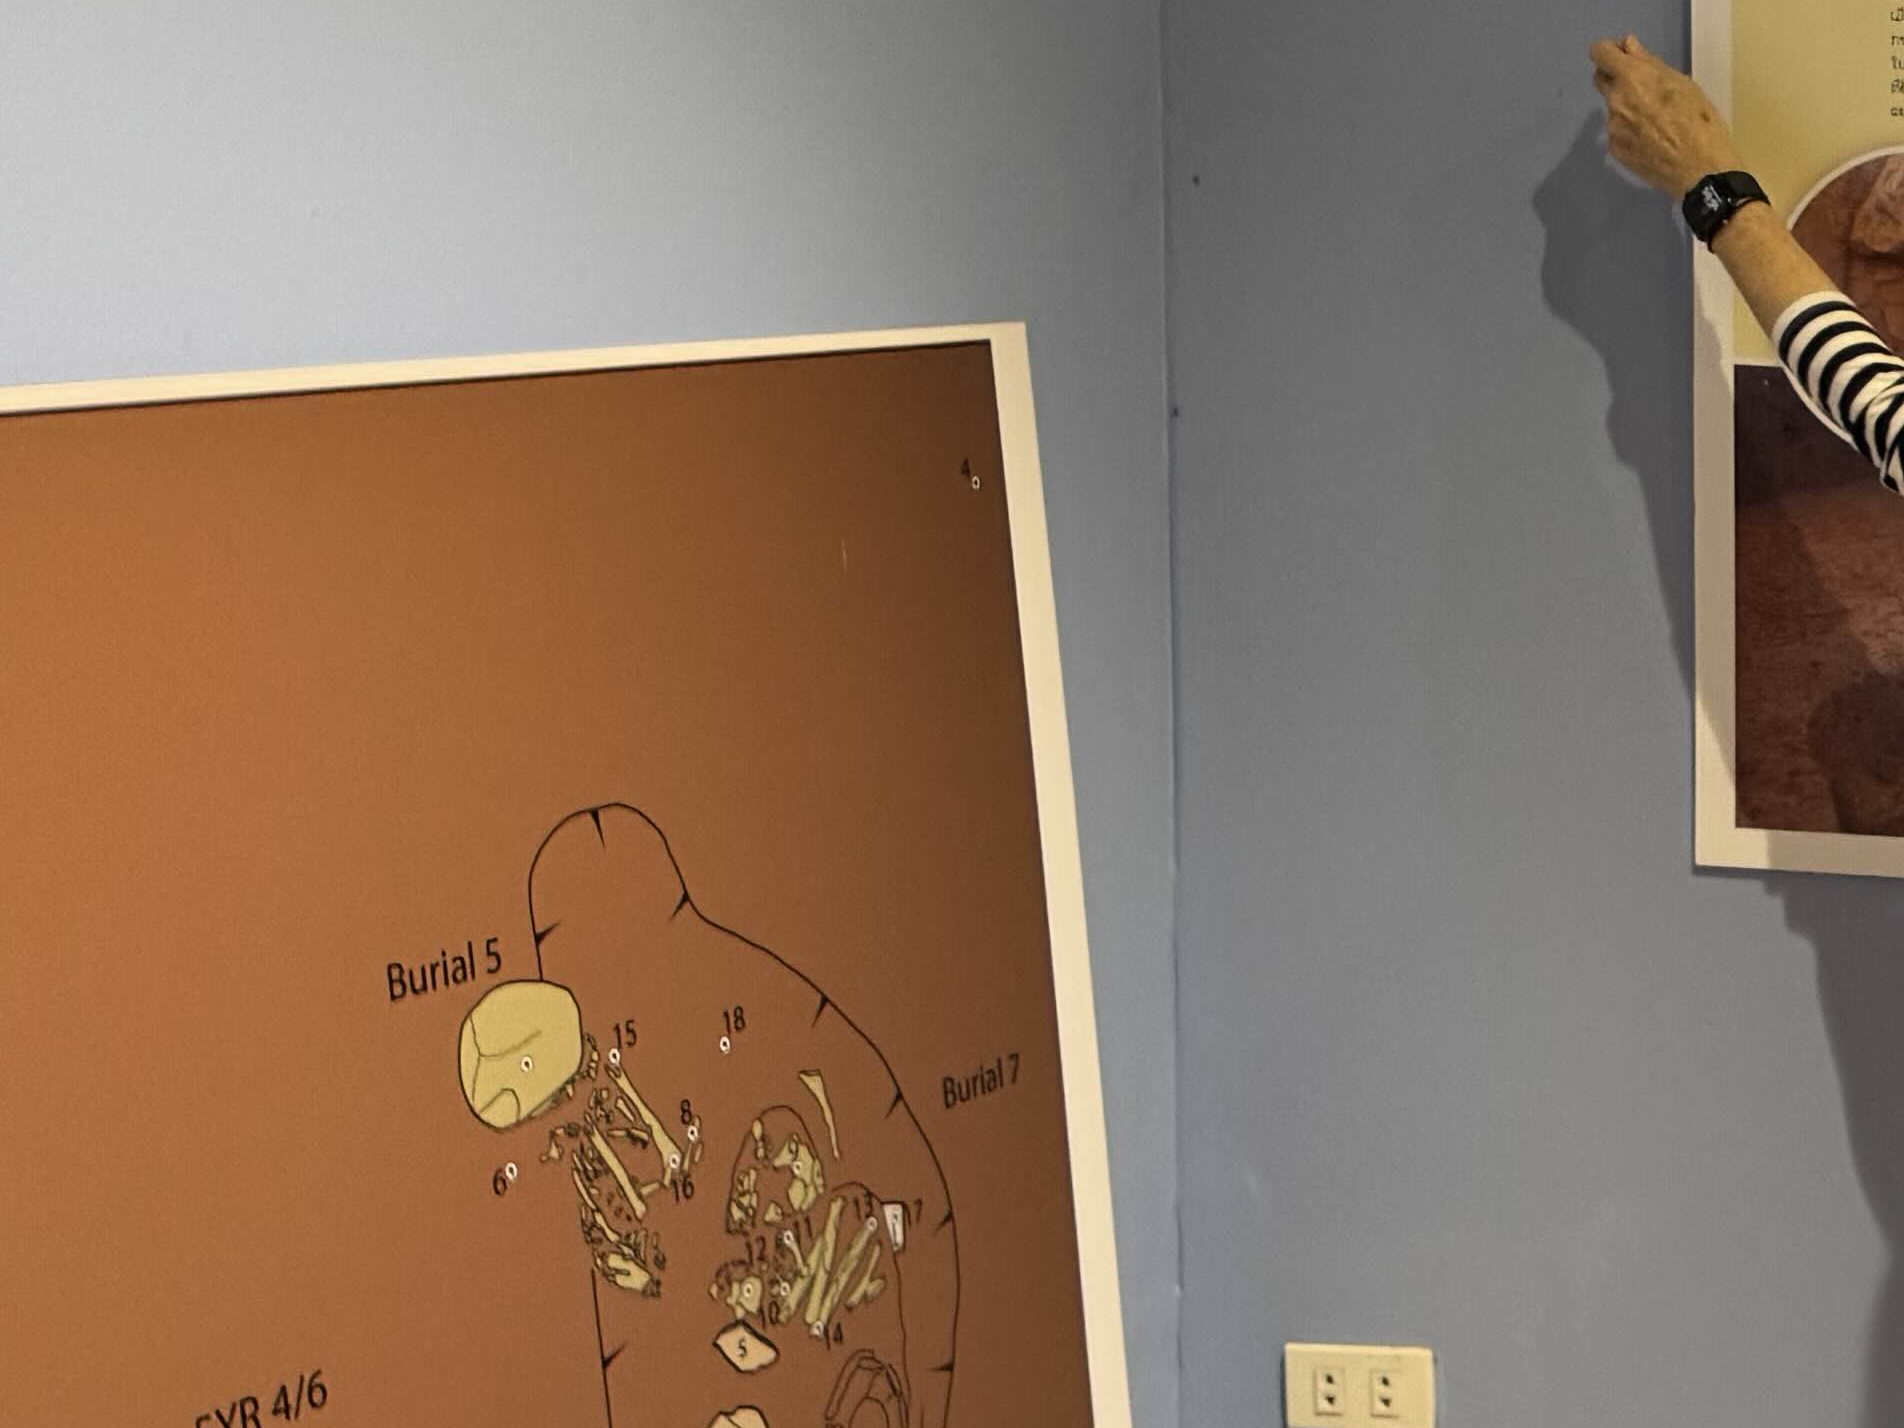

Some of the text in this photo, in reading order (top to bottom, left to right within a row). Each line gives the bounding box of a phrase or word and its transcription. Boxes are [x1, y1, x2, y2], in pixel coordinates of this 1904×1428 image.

[387, 937, 501, 1001] Burial 5
[613, 1020, 637, 1050] 15
[723, 1006, 745, 1035] 18
[943, 1052, 1019, 1108] Burial 7
[493, 1168, 507, 1196] 6
[670, 1176, 694, 1204] 16
[272, 1370, 327, 1420] 4/6
